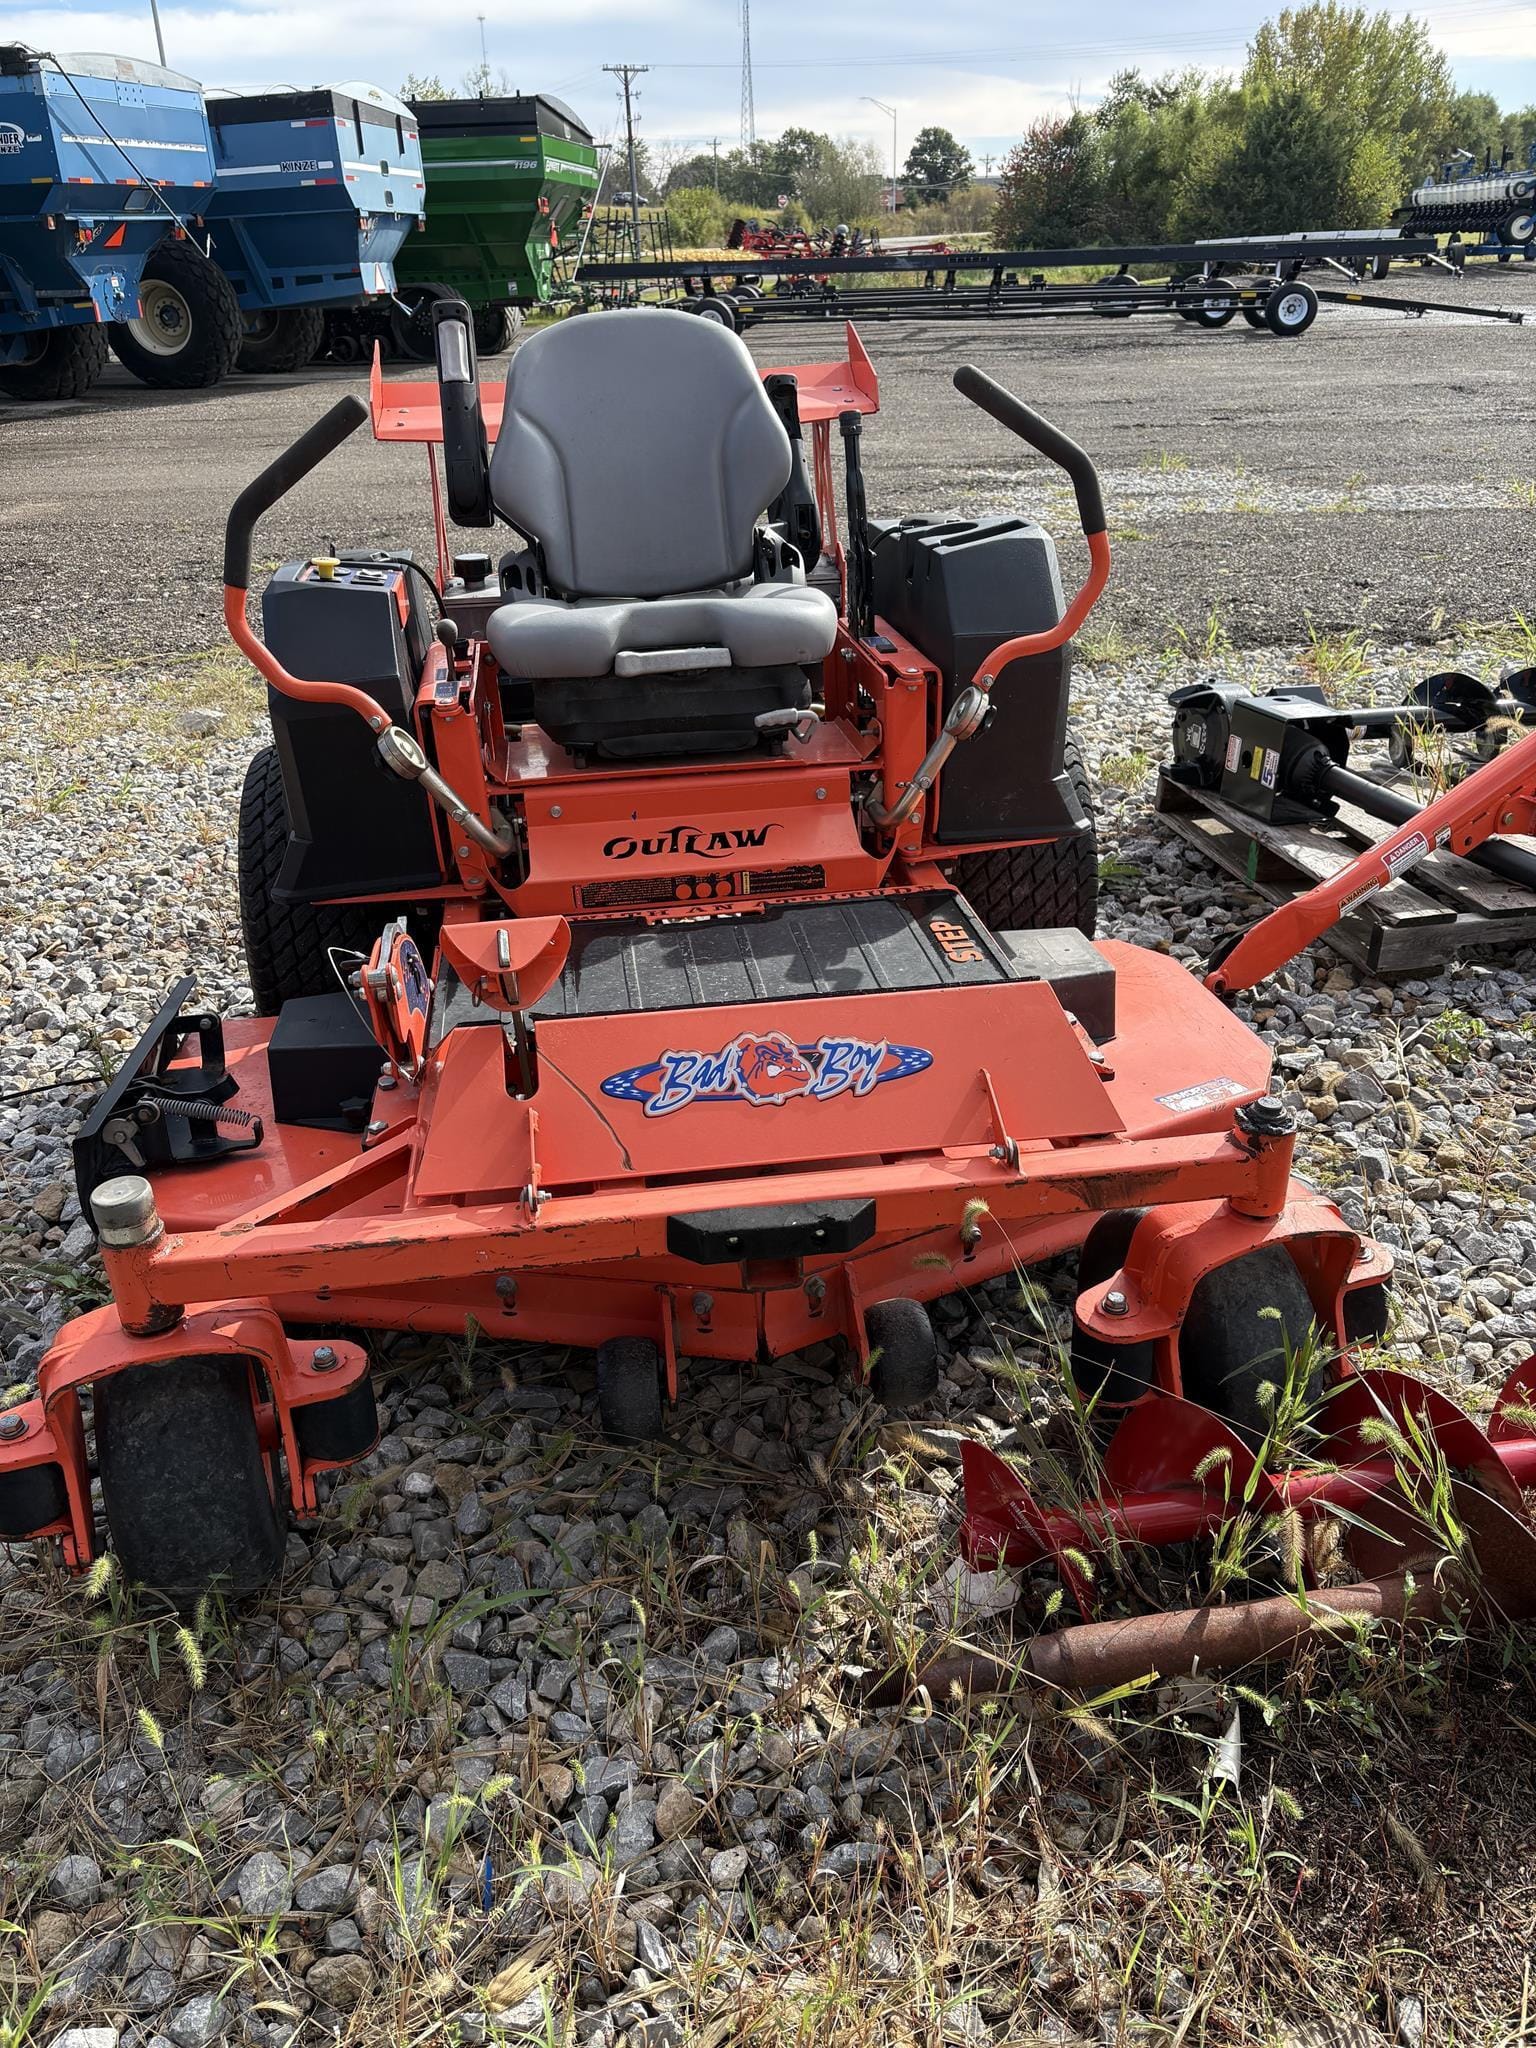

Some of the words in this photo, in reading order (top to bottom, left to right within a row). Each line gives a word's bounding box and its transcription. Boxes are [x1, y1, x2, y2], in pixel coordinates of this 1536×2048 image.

[281, 160, 318, 172] KINZE
[514, 161, 537, 169] 1196
[1394, 837, 1420, 857] DANGER
[1346, 878, 1379, 902] WARNING
[929, 921, 984, 963] STEP
[648, 1047, 735, 1113] Bad
[810, 1040, 886, 1095] Boy
